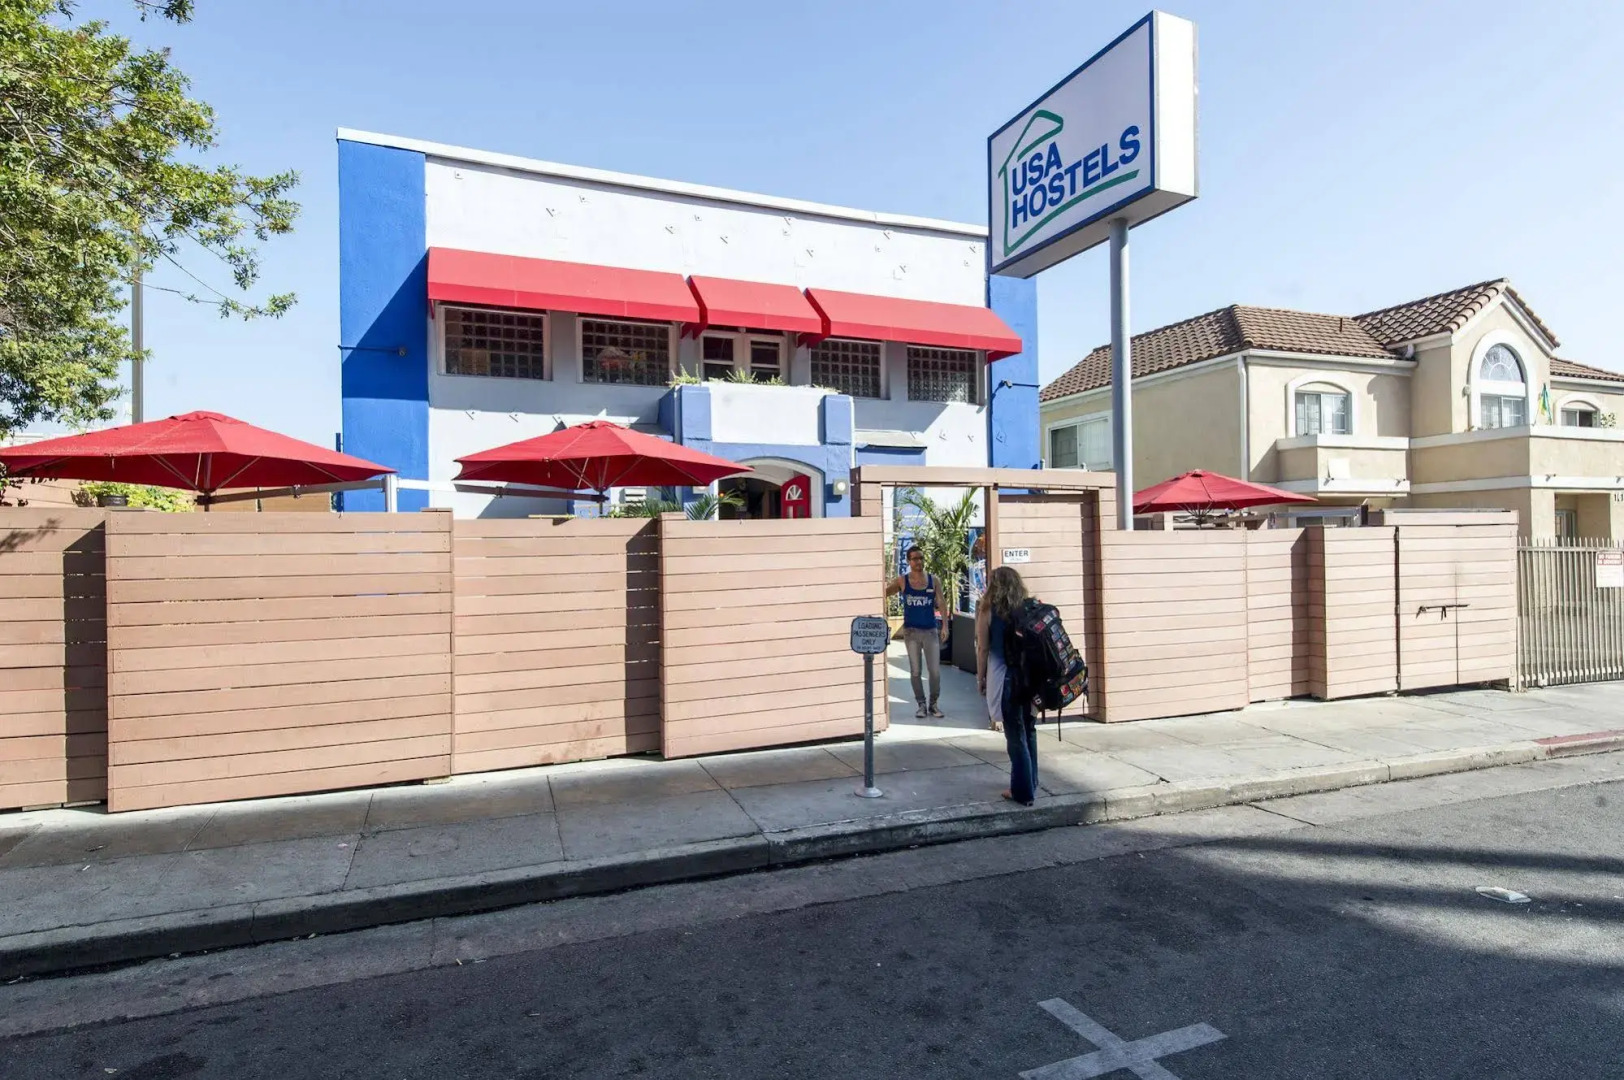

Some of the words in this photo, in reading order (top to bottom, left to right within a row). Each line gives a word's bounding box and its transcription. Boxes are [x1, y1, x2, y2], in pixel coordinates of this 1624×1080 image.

[1012, 141, 1062, 196] USA
[1012, 125, 1141, 229] HOSTELS
[907, 598, 933, 606] STAFF
